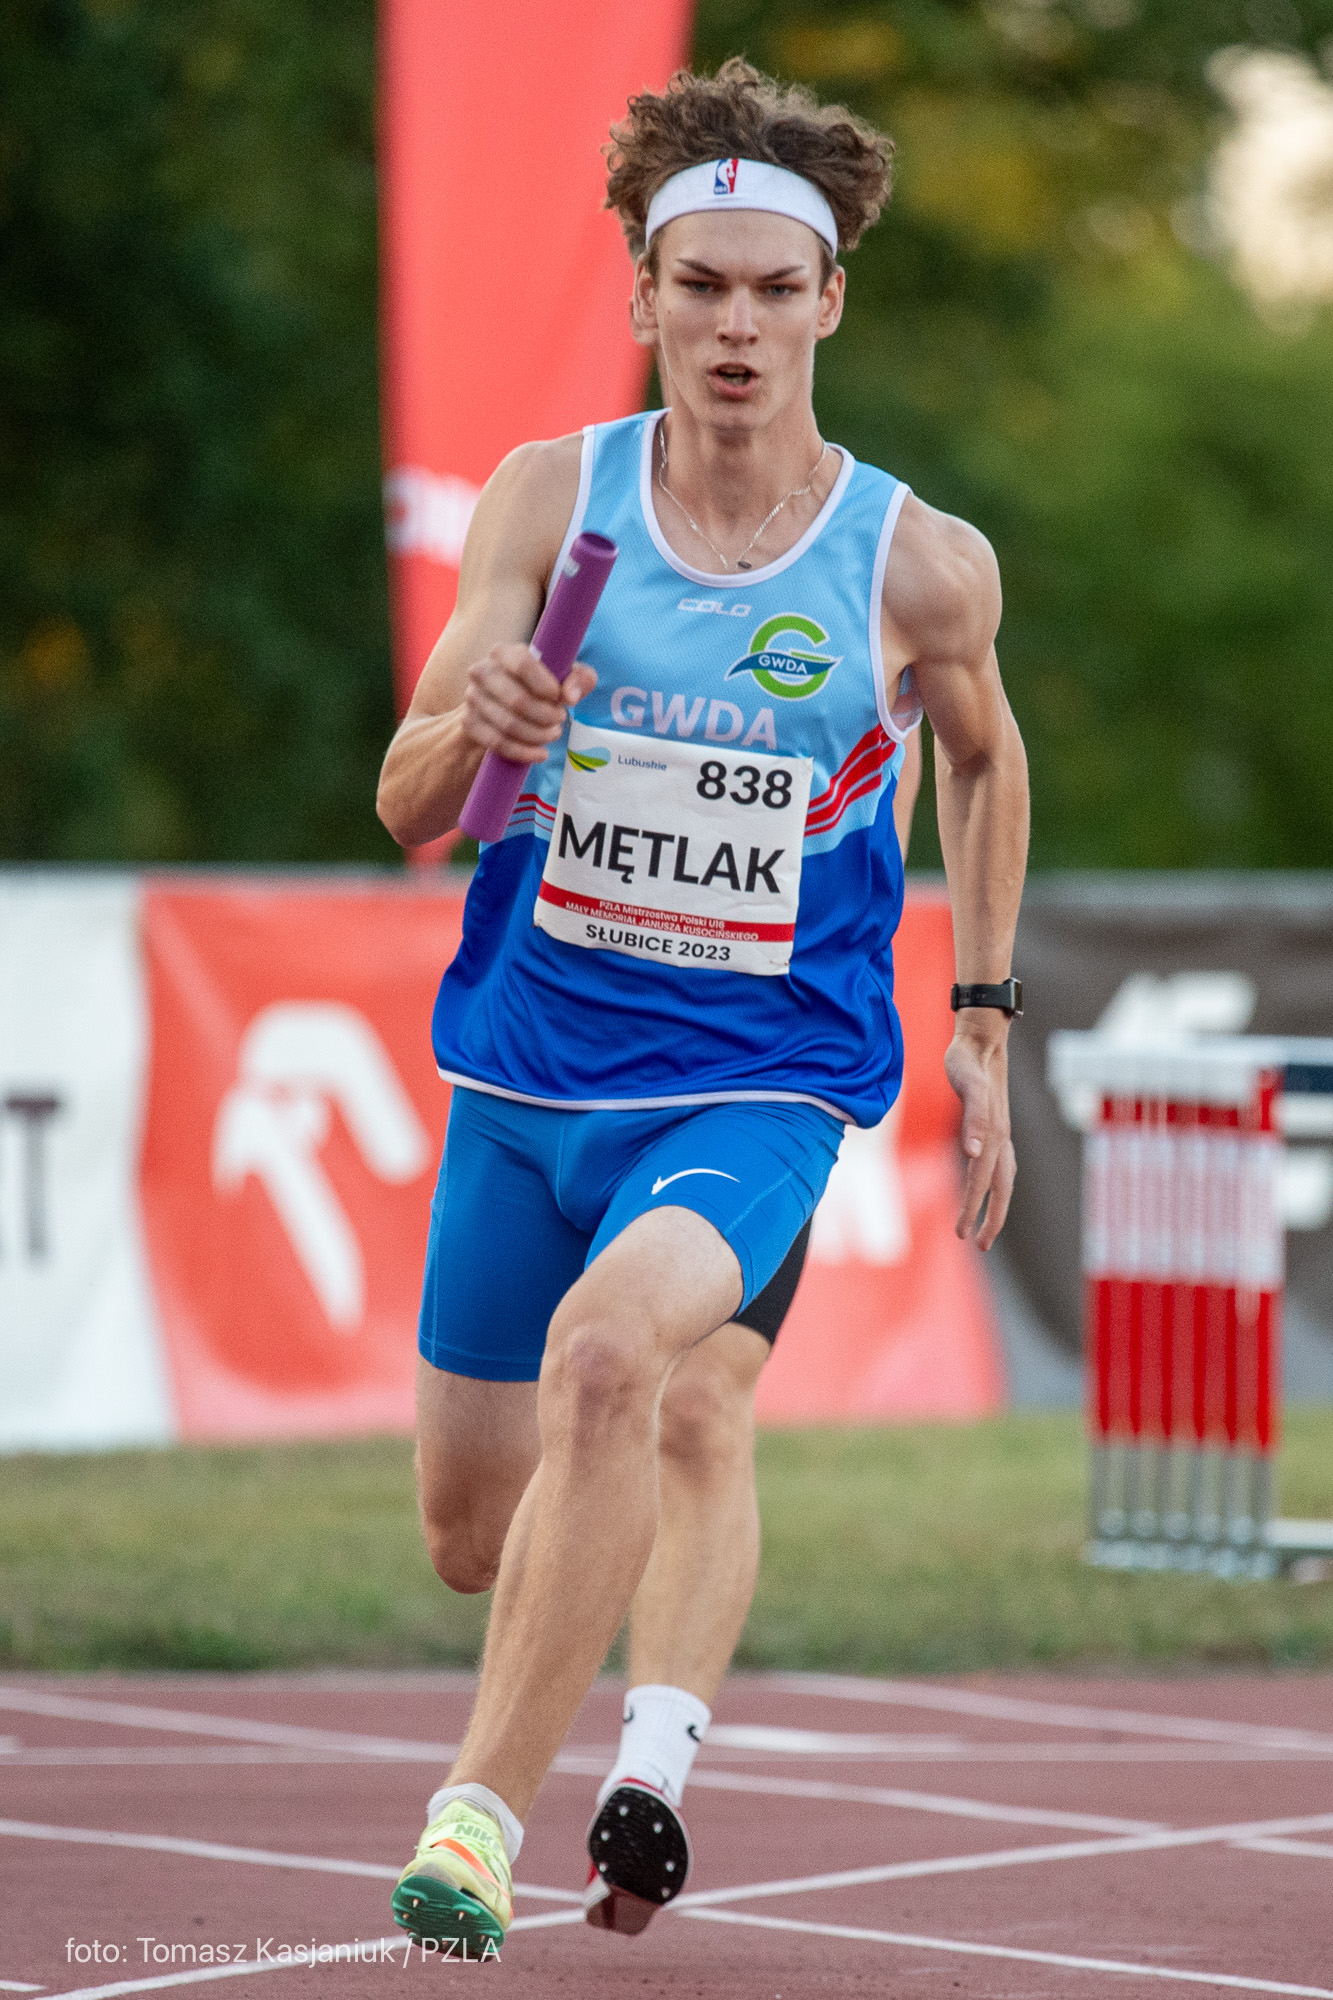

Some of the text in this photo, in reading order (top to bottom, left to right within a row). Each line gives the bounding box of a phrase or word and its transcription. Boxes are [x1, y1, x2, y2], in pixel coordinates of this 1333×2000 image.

[677, 598, 752, 618] COLO
[758, 654, 808, 675] GWDA
[610, 686, 777, 750] GWDA
[696, 760, 793, 810] 838
[558, 812, 785, 894] MĘTLAK
[566, 901, 589, 915] MAŁY
[638, 918, 681, 932] JANUSZA
[599, 900, 621, 912] PZLA
[622, 906, 678, 921] Mistrzostwa
[679, 914, 707, 927] Polski
[586, 924, 731, 961] SŁUBICE 2023
